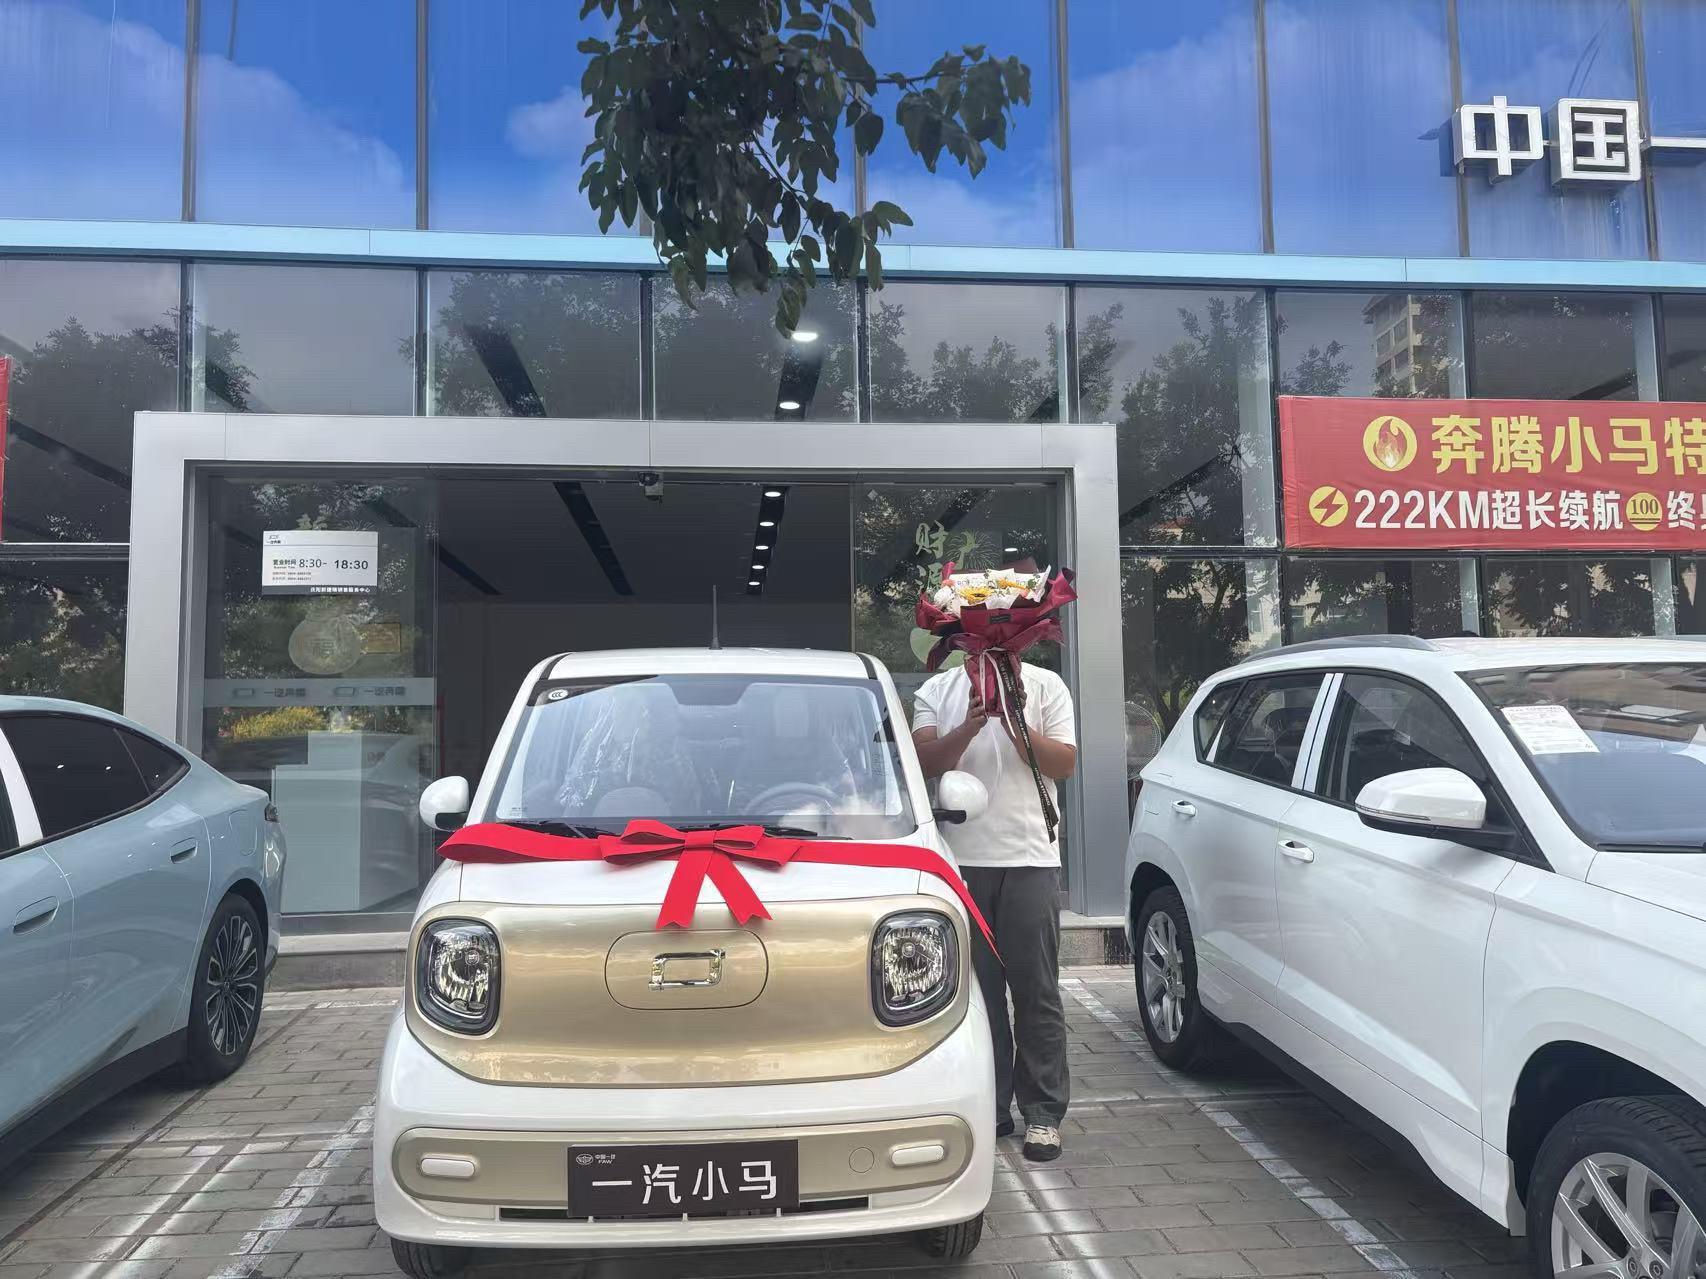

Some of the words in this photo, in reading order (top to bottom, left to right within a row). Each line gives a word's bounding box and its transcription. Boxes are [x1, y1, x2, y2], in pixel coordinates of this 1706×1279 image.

[1430, 414, 1706, 476] 奔腾小马特
[1354, 488, 1624, 531] 222KM超长续航
[272, 558, 297, 566] 营业时间
[334, 559, 369, 570] 18:30
[591, 1160, 777, 1205] 一汽小马
